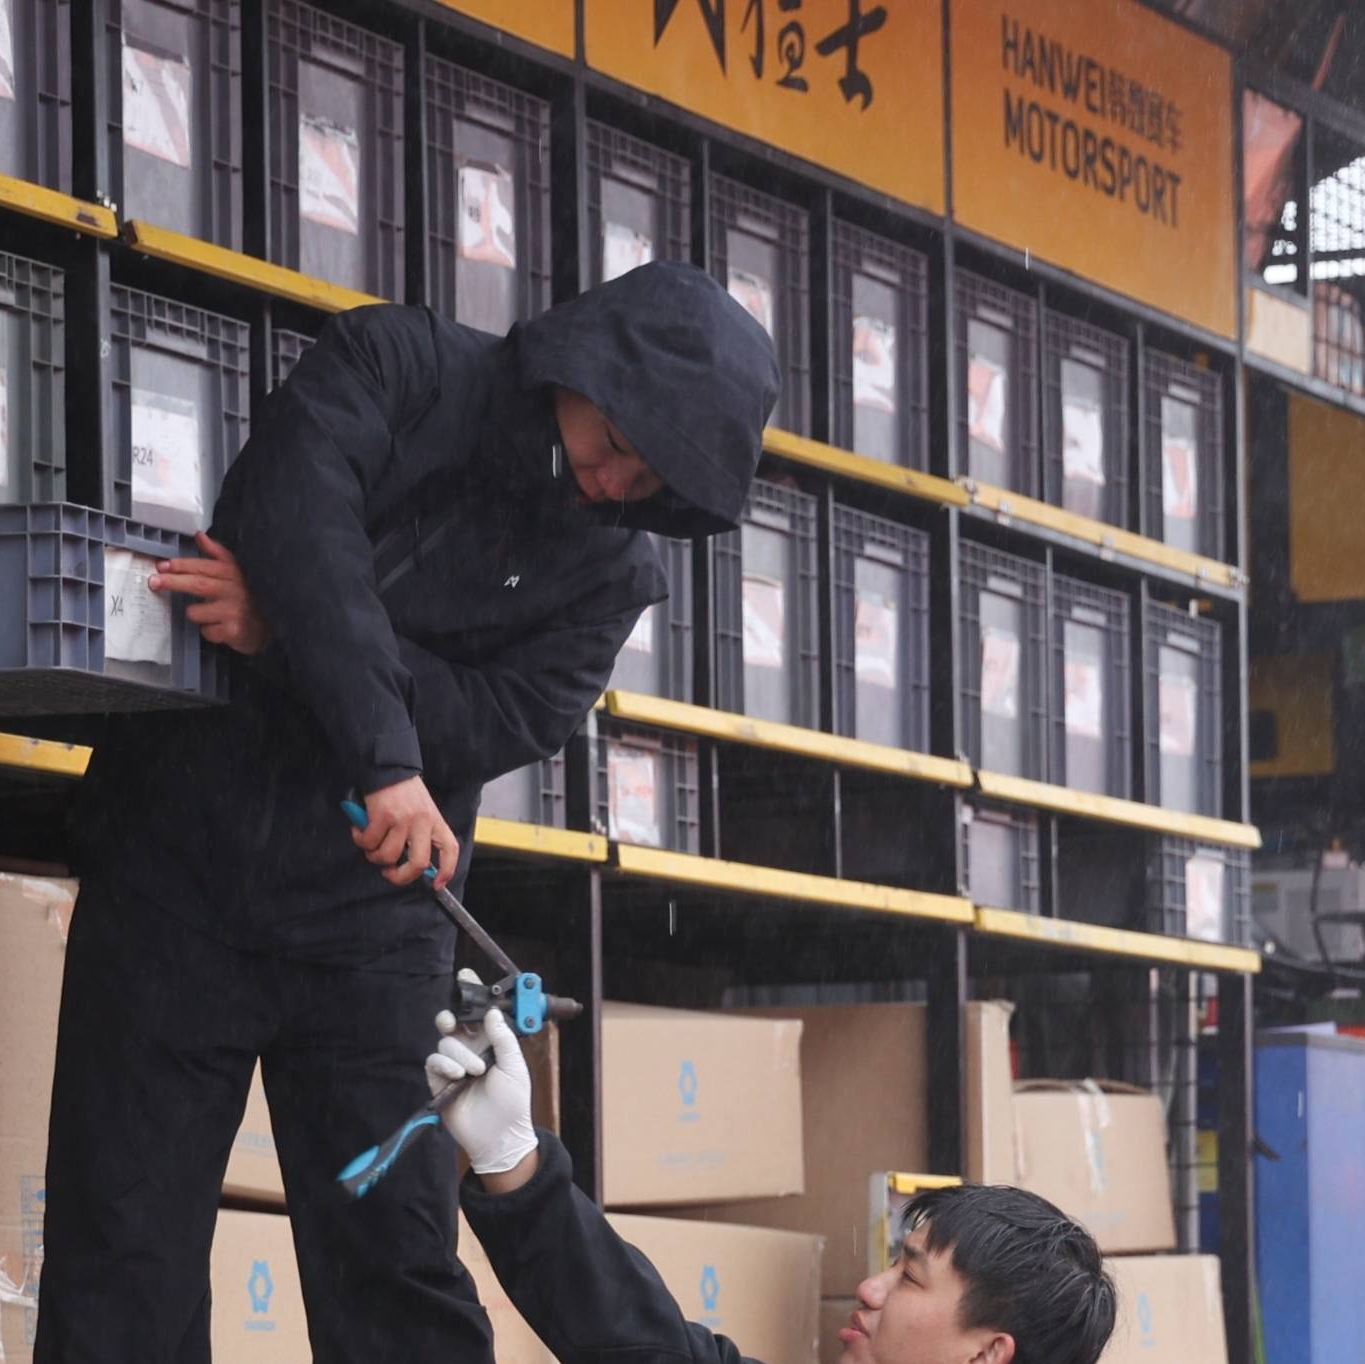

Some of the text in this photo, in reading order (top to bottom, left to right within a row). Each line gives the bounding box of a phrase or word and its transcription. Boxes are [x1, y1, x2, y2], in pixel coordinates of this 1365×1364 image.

[1001, 12, 1106, 119] HANWEI
[1003, 86, 1182, 229] MOTORSPORT
[132, 445, 155, 468] R24
[110, 594, 125, 617] X4
